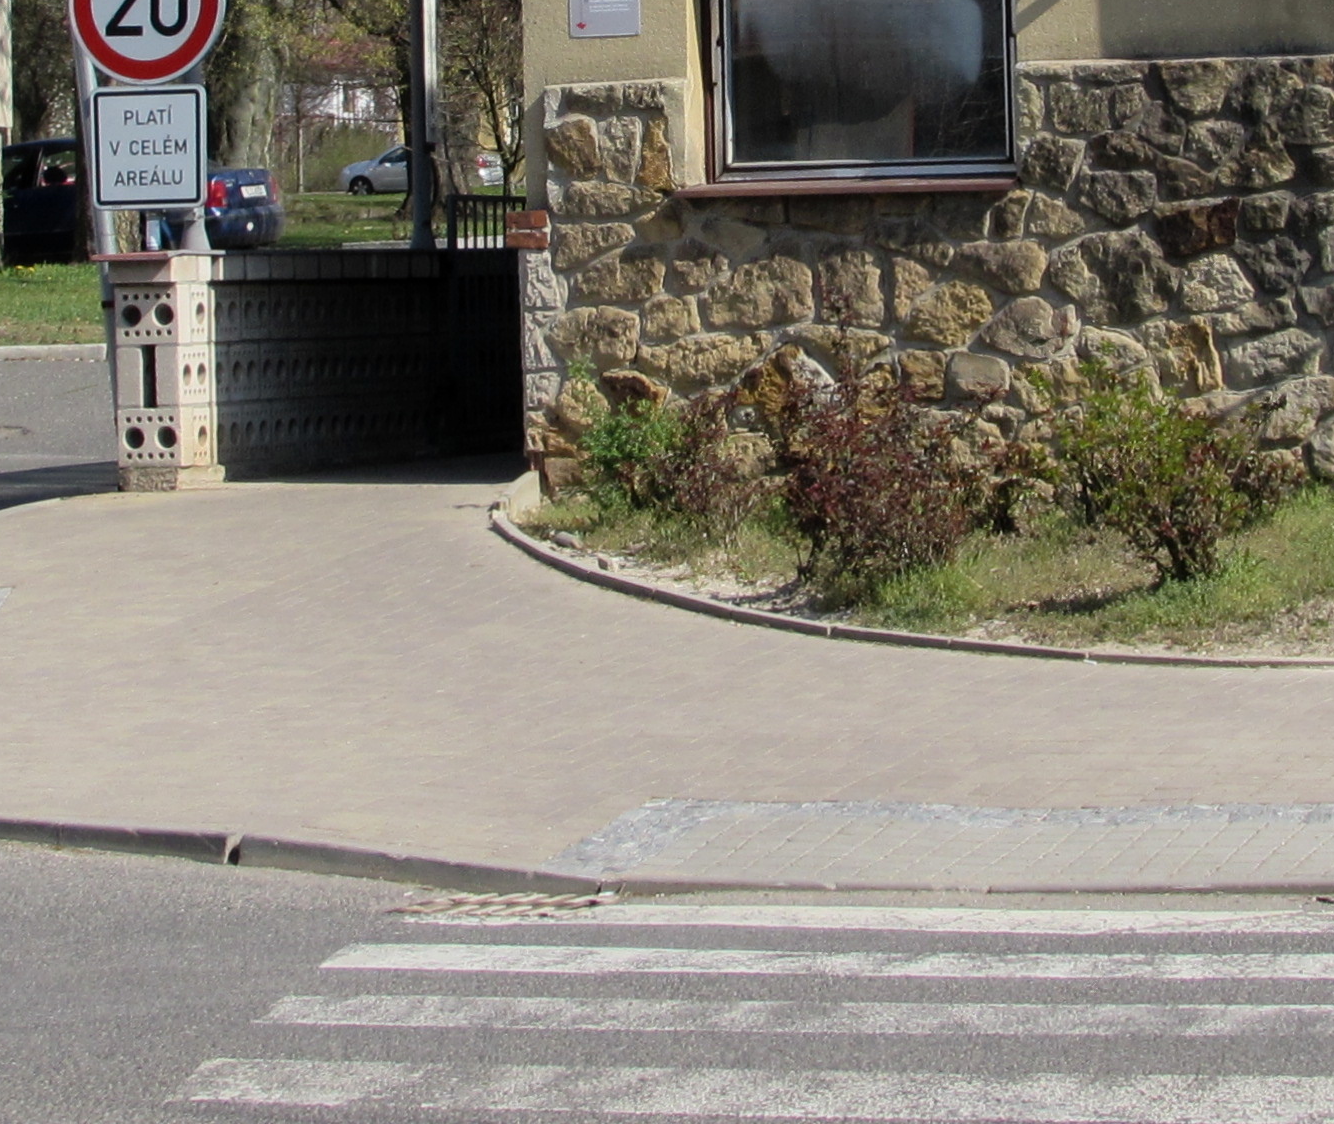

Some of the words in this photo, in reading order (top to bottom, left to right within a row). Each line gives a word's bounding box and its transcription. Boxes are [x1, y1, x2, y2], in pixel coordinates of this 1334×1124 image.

[123, 104, 173, 126] PLATÍ
[109, 140, 121, 157] V
[128, 135, 188, 156] CELÉM
[113, 166, 184, 187] AREÁLU
